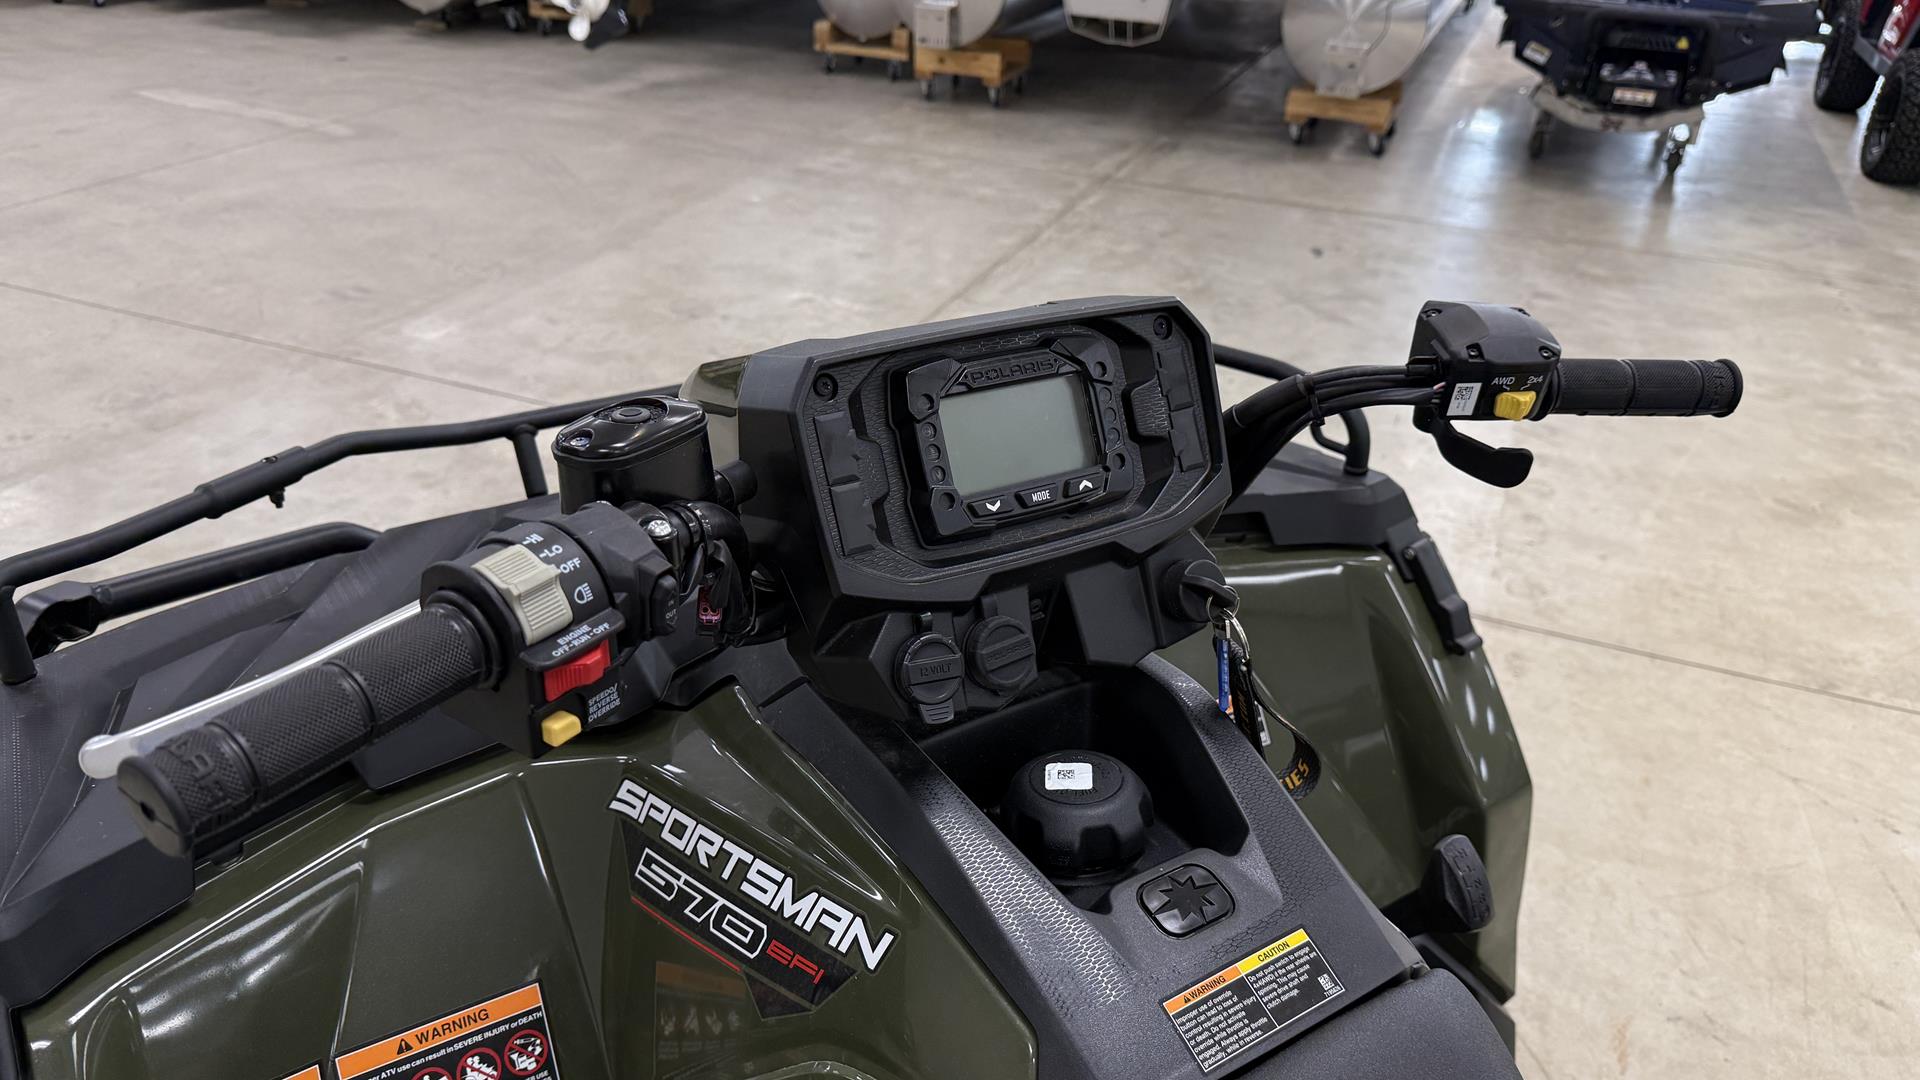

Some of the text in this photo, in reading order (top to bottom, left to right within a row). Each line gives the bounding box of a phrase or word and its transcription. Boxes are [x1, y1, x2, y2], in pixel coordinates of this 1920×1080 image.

[969, 359, 1055, 383] POLARIS
[1491, 375, 1544, 386] AWD 2x4
[1031, 489, 1051, 503] MODE
[665, 608, 677, 619] OUT
[557, 624, 592, 645] ENGINE
[930, 663, 952, 676] VOLT
[588, 697, 621, 723] OVERRIDE
[589, 691, 619, 714] REVERSE
[608, 779, 895, 971] SPORTSMAN
[635, 847, 825, 985] 570 EFI
[1257, 940, 1290, 962] CAUTION
[1188, 975, 1226, 999] WARNING
[415, 1008, 490, 1045] WARNING
[1175, 1008, 1198, 1024] Improper
[381, 1067, 396, 1080] ATV
[397, 1063, 411, 1073] use
[411, 1057, 425, 1067] can
[425, 1048, 447, 1062] result
[447, 1044, 454, 1053] in
[453, 1031, 484, 1051] SEVERE
[483, 1023, 511, 1042] INJURY
[510, 1020, 518, 1030] or
[518, 1010, 543, 1026] DEATH
